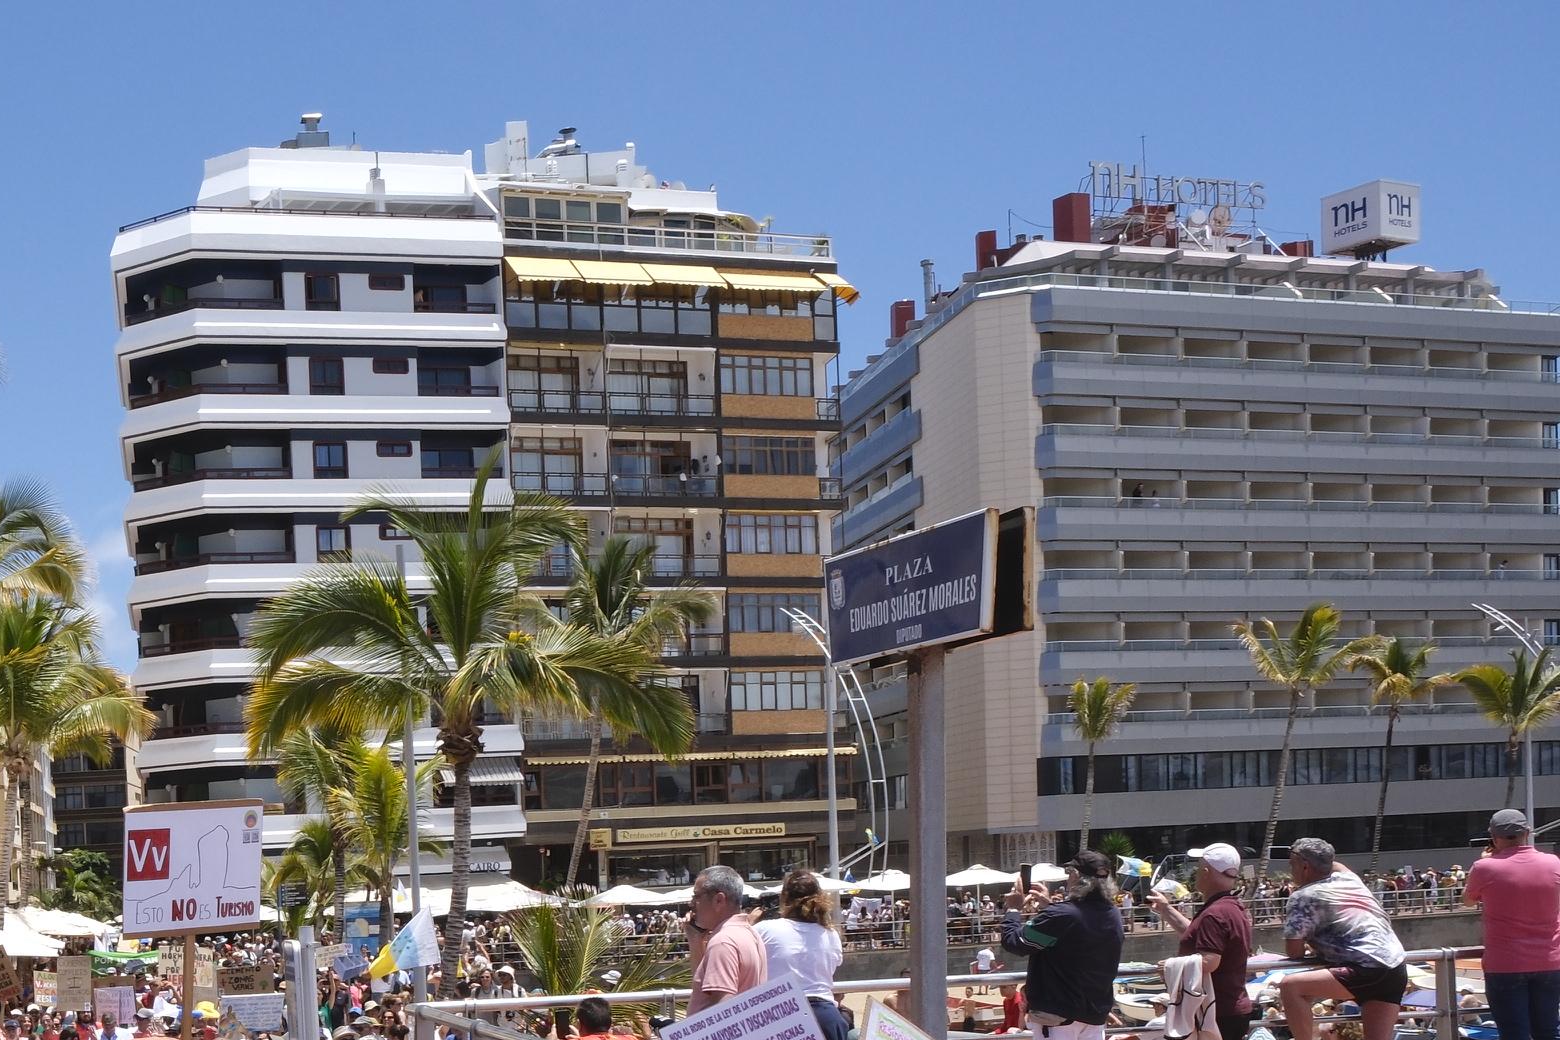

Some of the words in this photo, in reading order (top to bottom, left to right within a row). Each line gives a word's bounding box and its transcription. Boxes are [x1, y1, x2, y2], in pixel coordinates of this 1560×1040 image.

[1157, 175, 1266, 209] HOTELS
[1334, 221, 1368, 238] HOTELS
[1388, 217, 1412, 229] HOTELS
[885, 555, 933, 585] PLAZA
[850, 600, 889, 633] EDUARDO
[891, 588, 927, 623] SUÁREZ
[929, 574, 977, 612] MORALES
[896, 623, 922, 644] DIPUTADO
[702, 826, 730, 836] Casa
[734, 825, 783, 836] Carmelo
[171, 898, 197, 921] NO
[216, 896, 255, 918] TURISMO
[683, 1027, 691, 1036] AL
[706, 1017, 715, 1027] DE
[715, 1014, 723, 1023] LA
[721, 1009, 732, 1020] LEY
[733, 1005, 741, 1015] DE
[742, 1002, 750, 1011] LA
[749, 985, 788, 1007] DEPENDENCIA
[787, 981, 792, 990] A
[742, 1022, 749, 1034] Y
[746, 997, 800, 1032] DISCAPACITADAS
